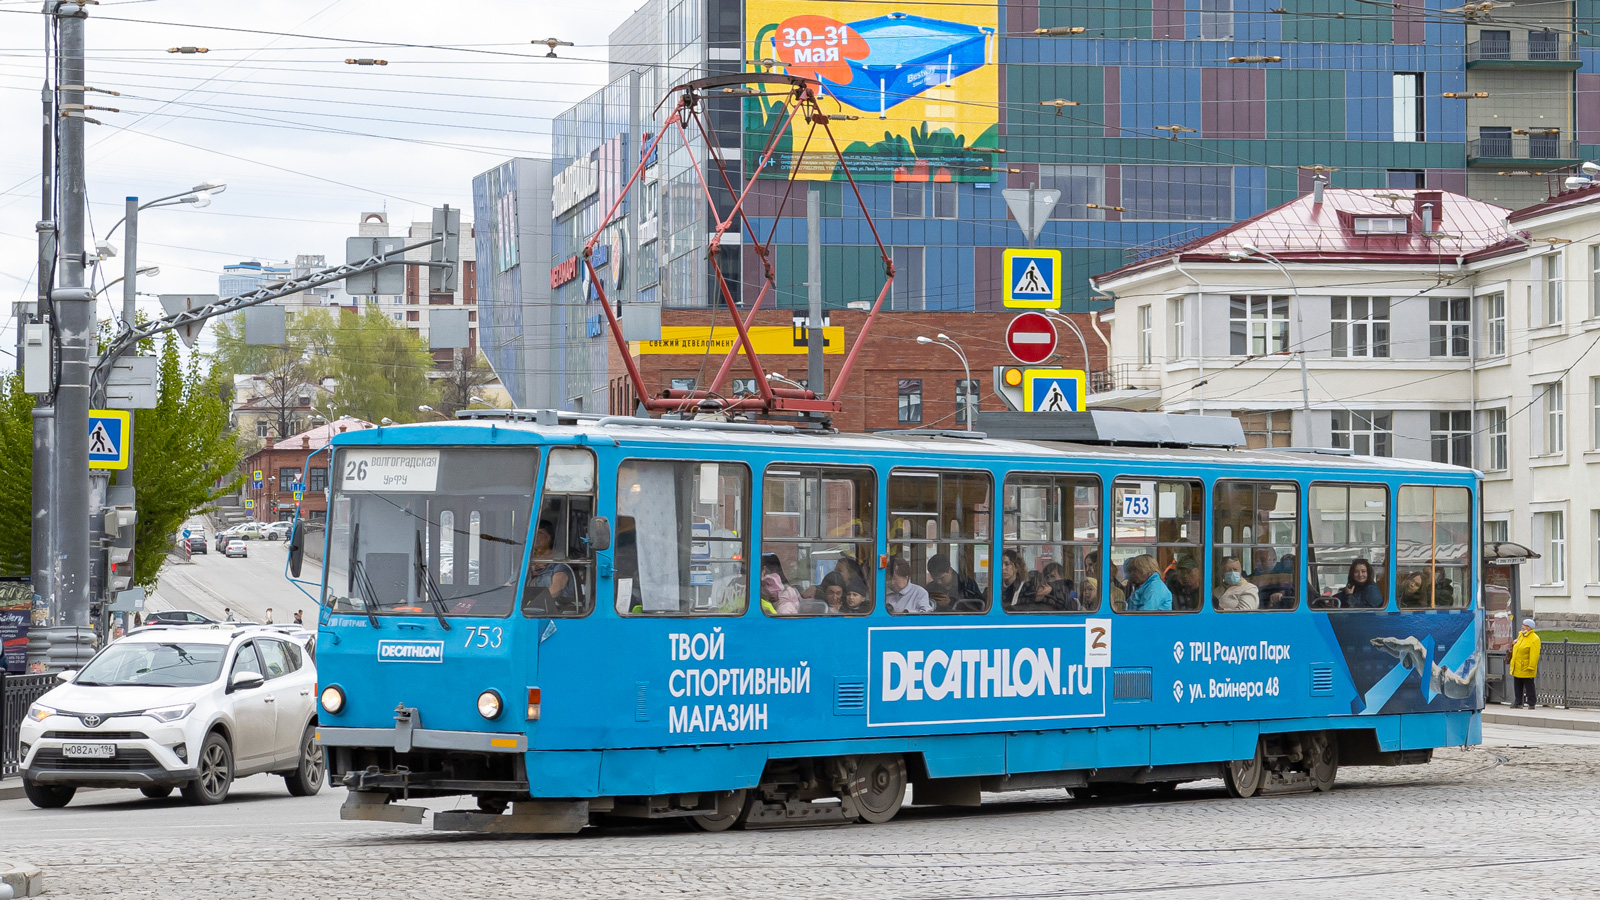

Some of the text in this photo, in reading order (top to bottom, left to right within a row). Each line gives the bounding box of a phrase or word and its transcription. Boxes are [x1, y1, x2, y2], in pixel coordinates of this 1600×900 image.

[649, 339, 735, 349] СВЕЖИЙ ДЕВЕЛОПМЕНТ
[345, 460, 368, 481] 26
[1125, 496, 1149, 515] 753
[464, 626, 503, 649] 753
[669, 627, 725, 661] ТВОЙ
[381, 644, 440, 658] DECATHLON
[1189, 641, 1290, 665] ТРЦ Радуга Парк
[668, 661, 811, 698] СПОРТИВНЫЙ
[882, 647, 1093, 702] DECATHLON.ru
[1189, 677, 1279, 703] ул. Вайнера 48
[668, 703, 768, 733] МАГАЗИН
[101, 745, 114, 753] 196
